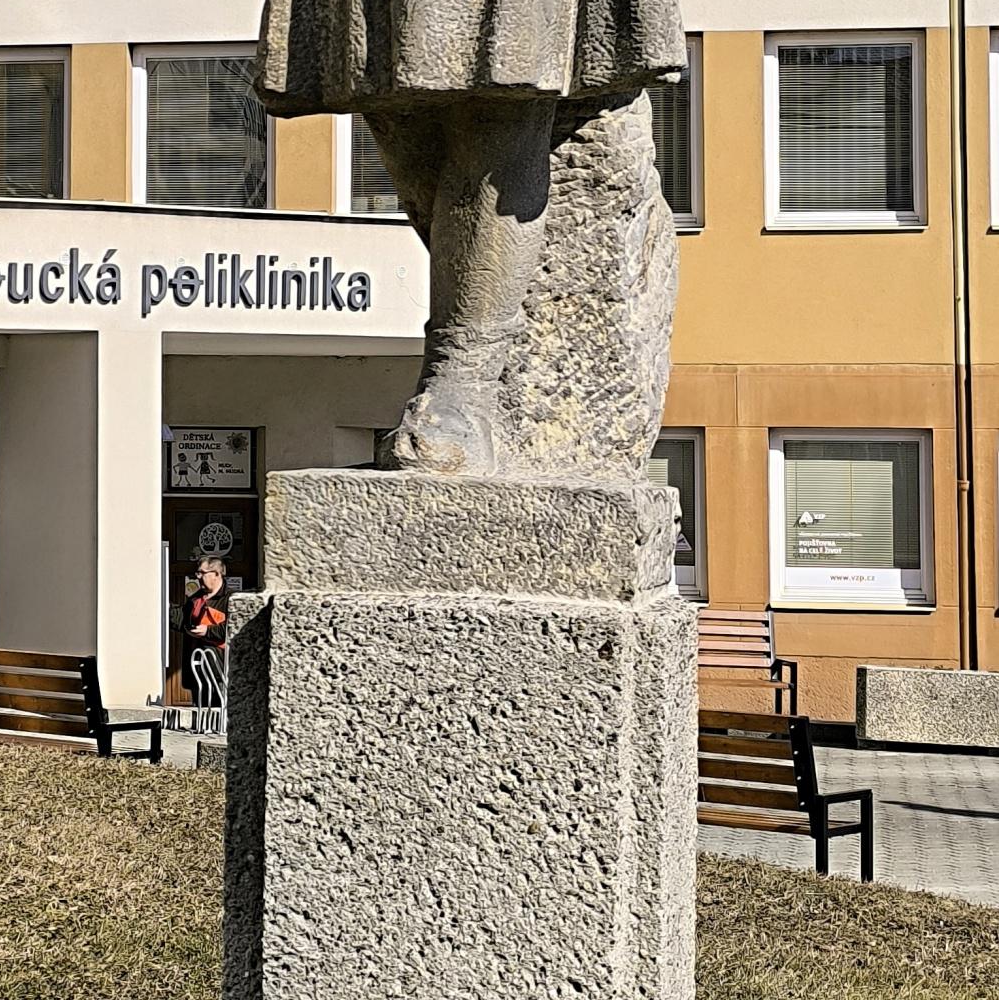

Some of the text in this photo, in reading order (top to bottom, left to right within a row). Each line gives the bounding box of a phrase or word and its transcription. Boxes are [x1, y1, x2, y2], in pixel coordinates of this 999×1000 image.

[141, 251, 372, 319] poliklinika
[178, 442, 222, 450] ORDINACE
[829, 575, 876, 583] www.vzp.cz
